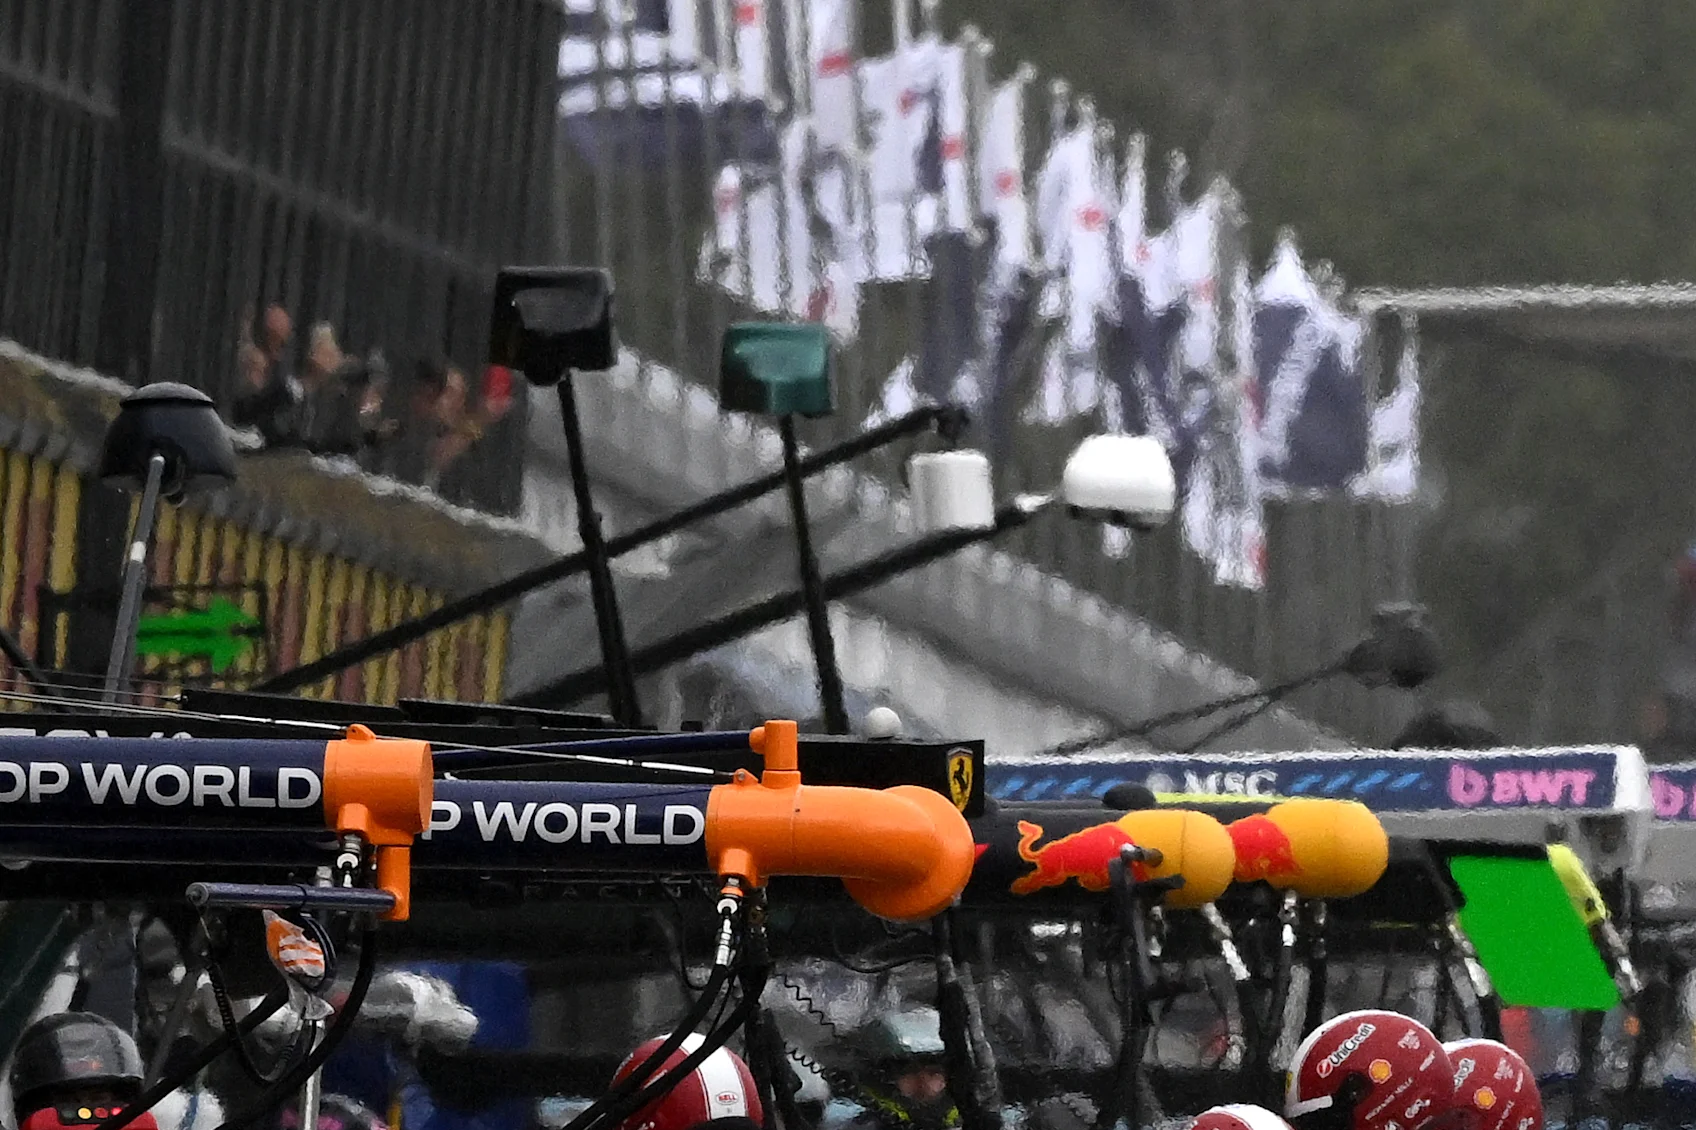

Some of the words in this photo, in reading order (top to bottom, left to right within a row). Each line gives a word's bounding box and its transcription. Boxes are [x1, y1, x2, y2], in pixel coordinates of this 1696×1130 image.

[80, 762, 322, 808] WORLD
[473, 800, 706, 845] WORLD
[1329, 1023, 1375, 1066] UniCredit
